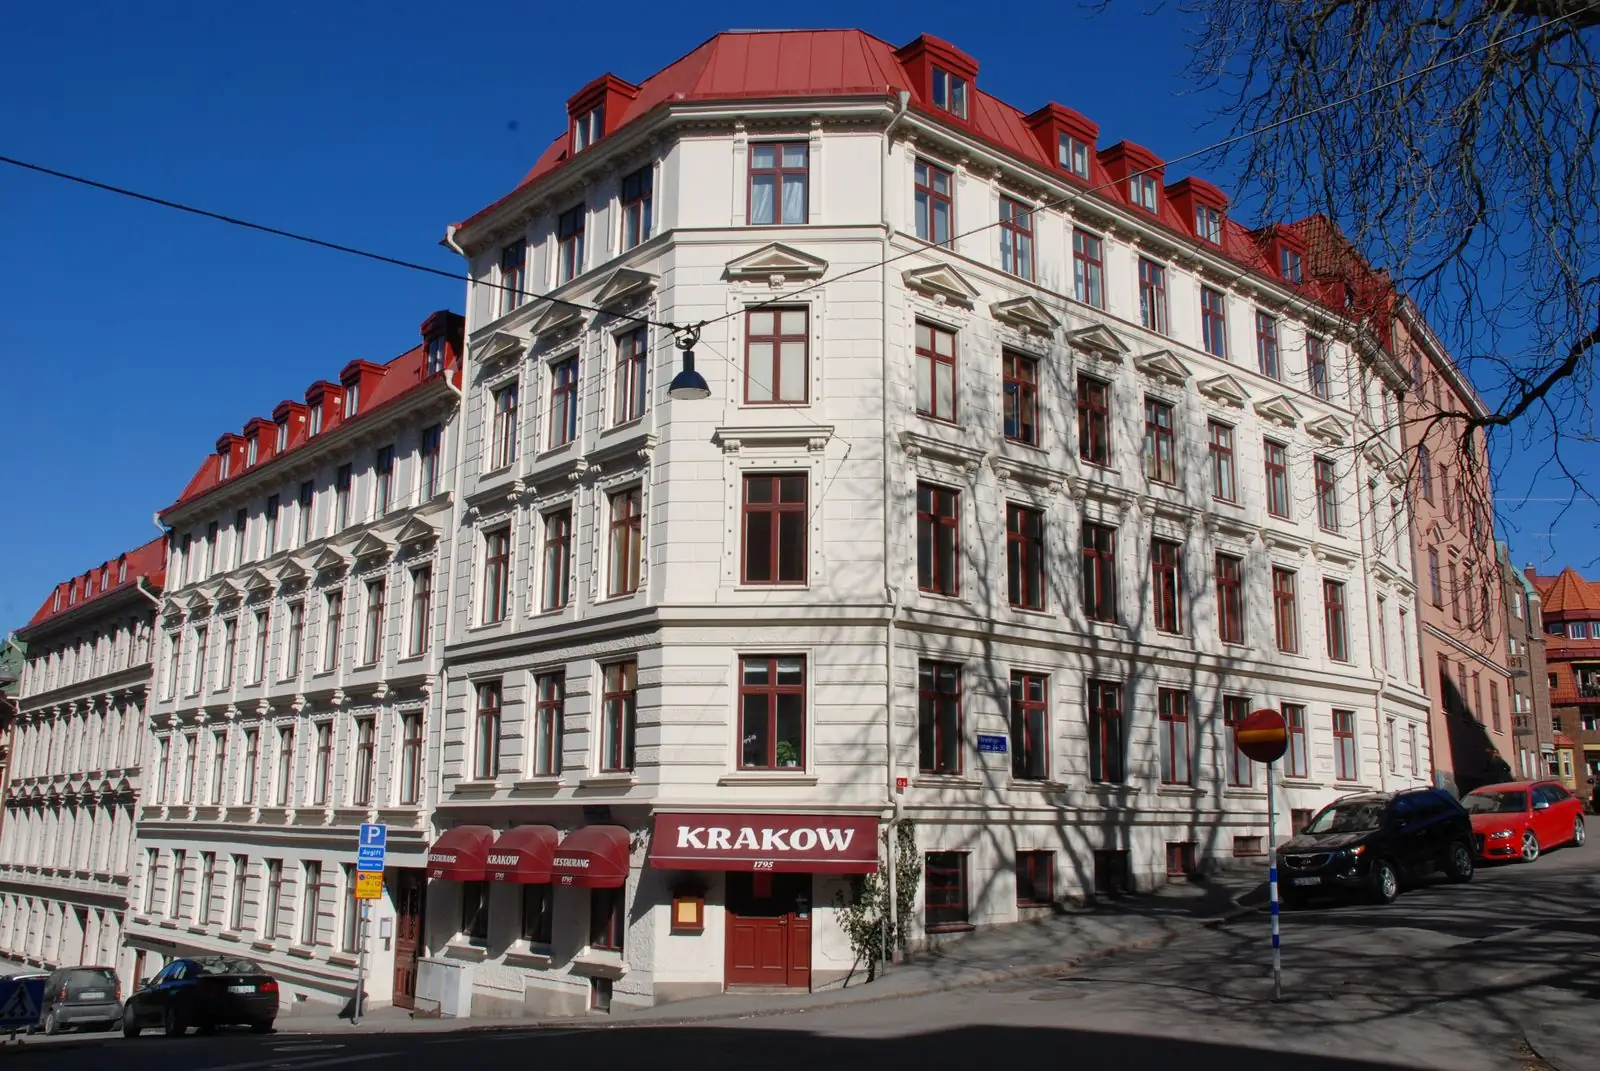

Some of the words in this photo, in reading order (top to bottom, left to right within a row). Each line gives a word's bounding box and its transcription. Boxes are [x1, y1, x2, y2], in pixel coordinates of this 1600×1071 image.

[367, 826, 380, 844] P
[676, 826, 855, 852] KRAKOW
[362, 848, 382, 857] Avgift
[487, 855, 519, 865] KRAKOW
[553, 858, 589, 868] RESTAURANG
